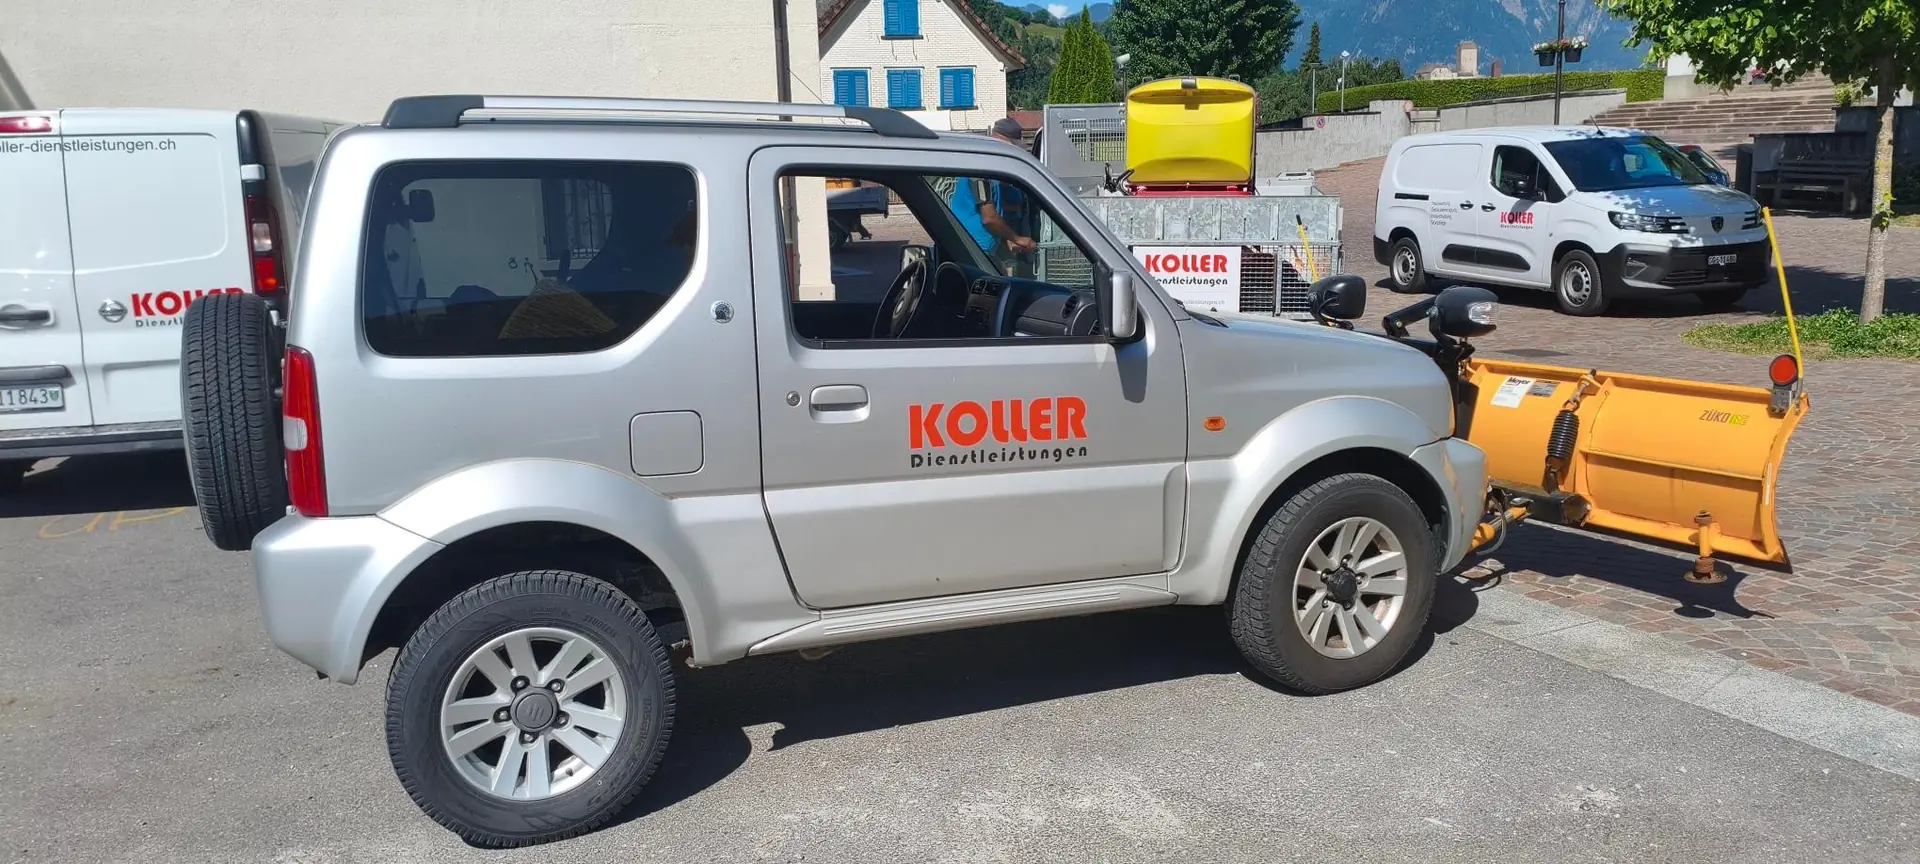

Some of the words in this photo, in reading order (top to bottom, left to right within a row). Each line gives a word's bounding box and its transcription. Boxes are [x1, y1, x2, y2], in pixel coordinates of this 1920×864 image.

[0, 138, 176, 153] ller-dienstleistungen.ch
[1145, 254, 1228, 273] KOLLER
[1156, 276, 1228, 287] enstleistungen
[131, 288, 244, 317] KOL
[908, 396, 1088, 449] KOLLER
[911, 447, 1087, 468] Dienstleistungen
